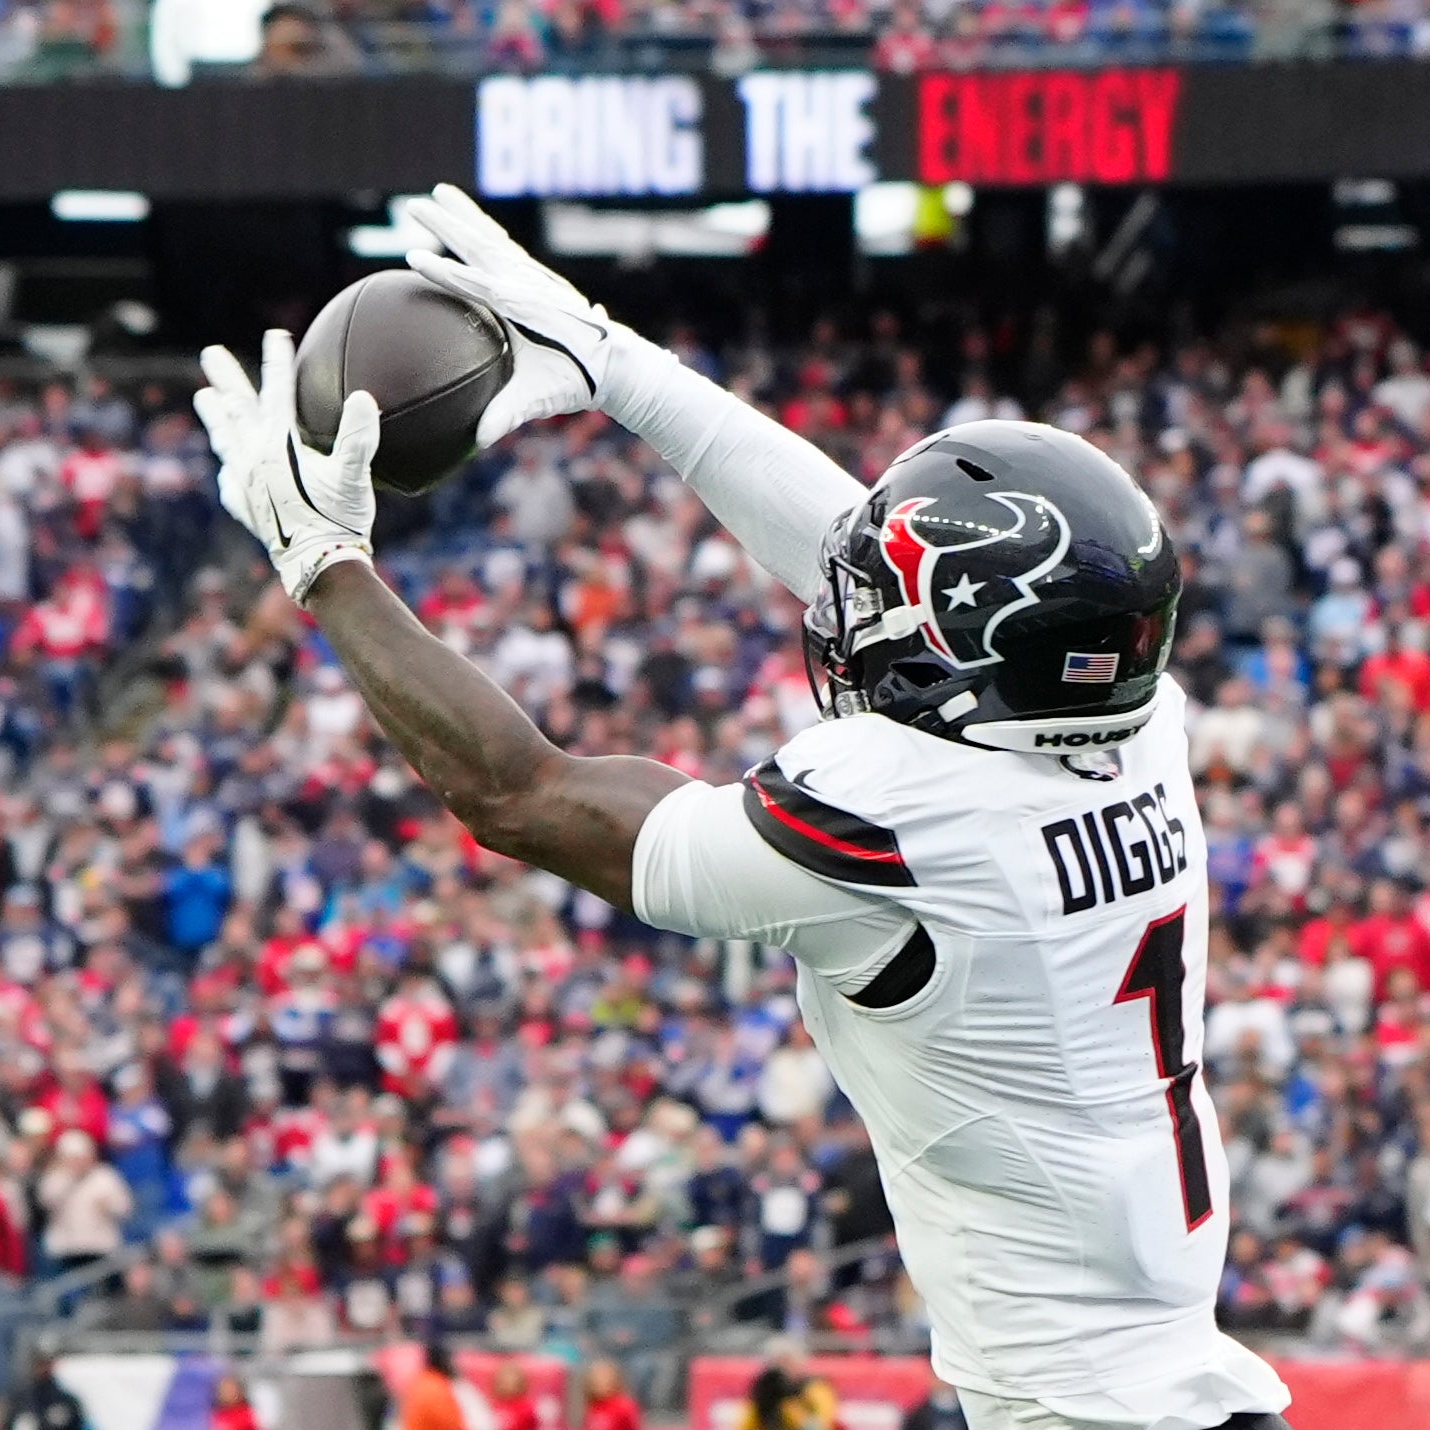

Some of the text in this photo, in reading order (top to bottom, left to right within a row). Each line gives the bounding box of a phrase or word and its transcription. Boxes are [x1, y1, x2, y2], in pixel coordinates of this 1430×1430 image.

[477, 70, 1181, 195] BRING THE ENERGY
[1041, 782, 1187, 916] DIGGS
[1112, 902, 1213, 1233] 1
